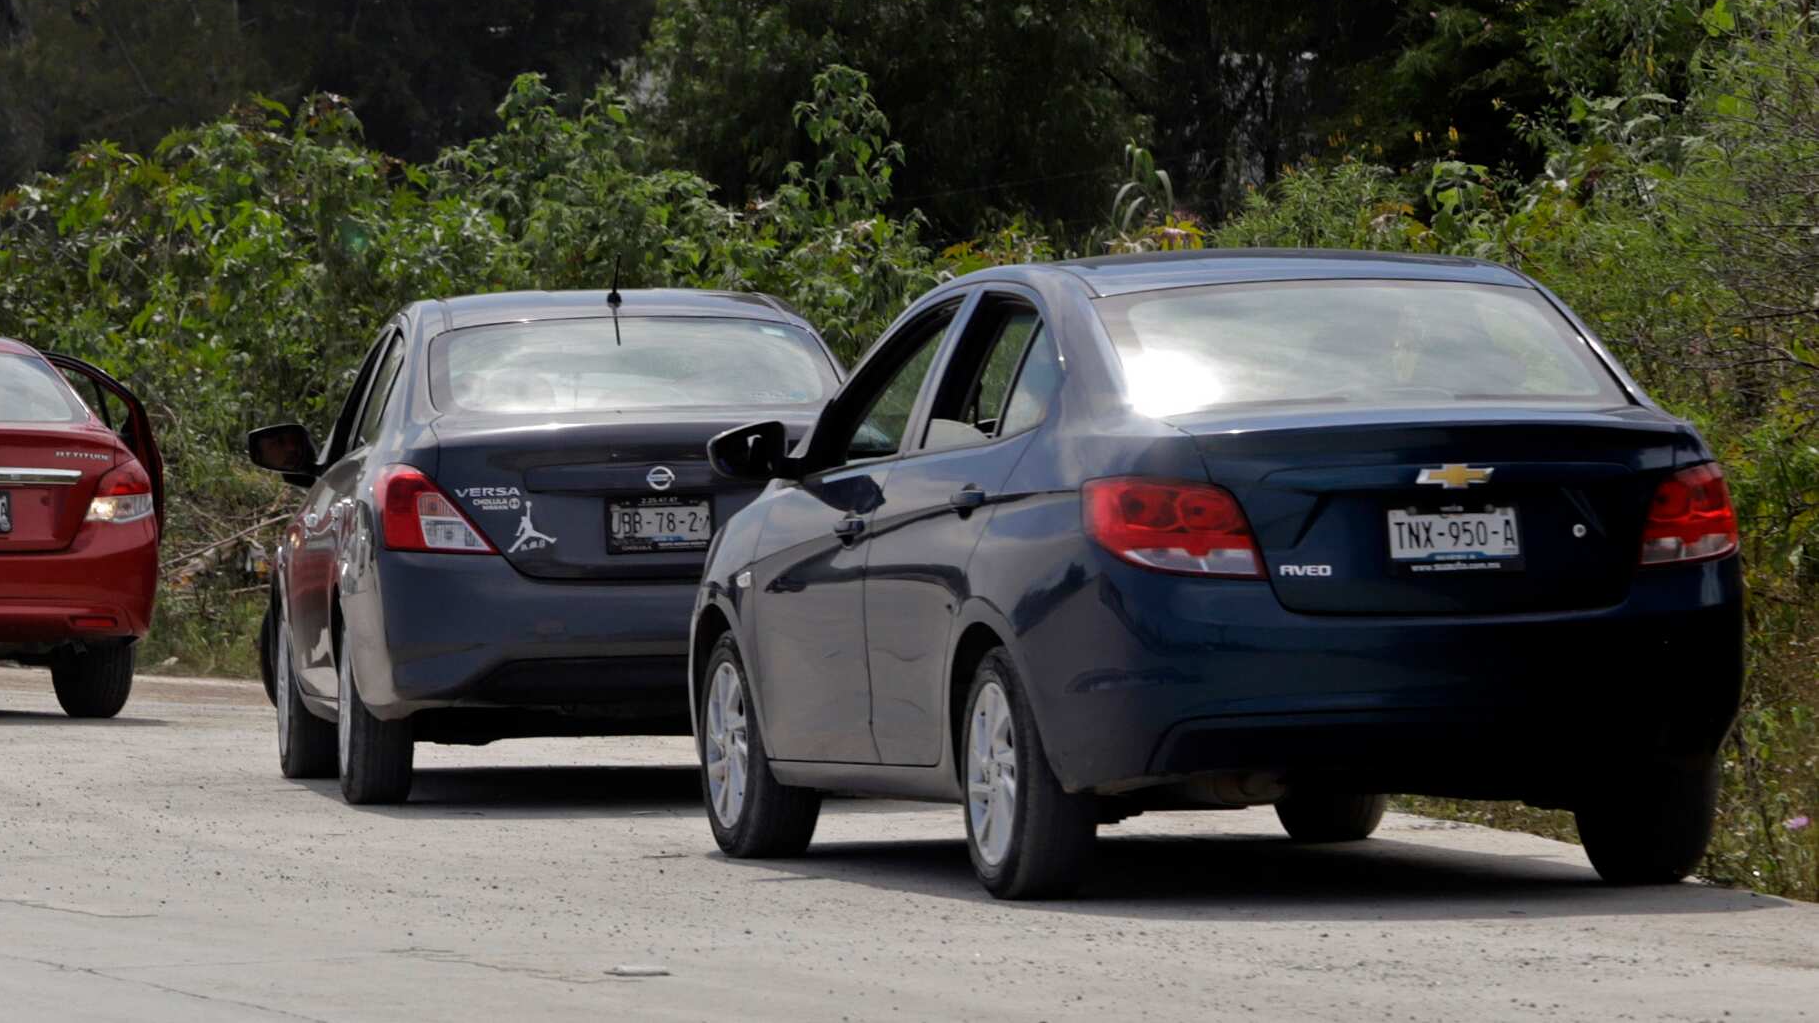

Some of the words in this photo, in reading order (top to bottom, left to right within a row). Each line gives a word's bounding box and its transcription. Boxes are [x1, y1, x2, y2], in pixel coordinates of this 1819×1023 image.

[454, 486, 521, 497] VERSA
[472, 498, 508, 506] CHOLULA
[1394, 519, 1516, 550] TNX-950-A
[1279, 564, 1332, 576] AVEO
